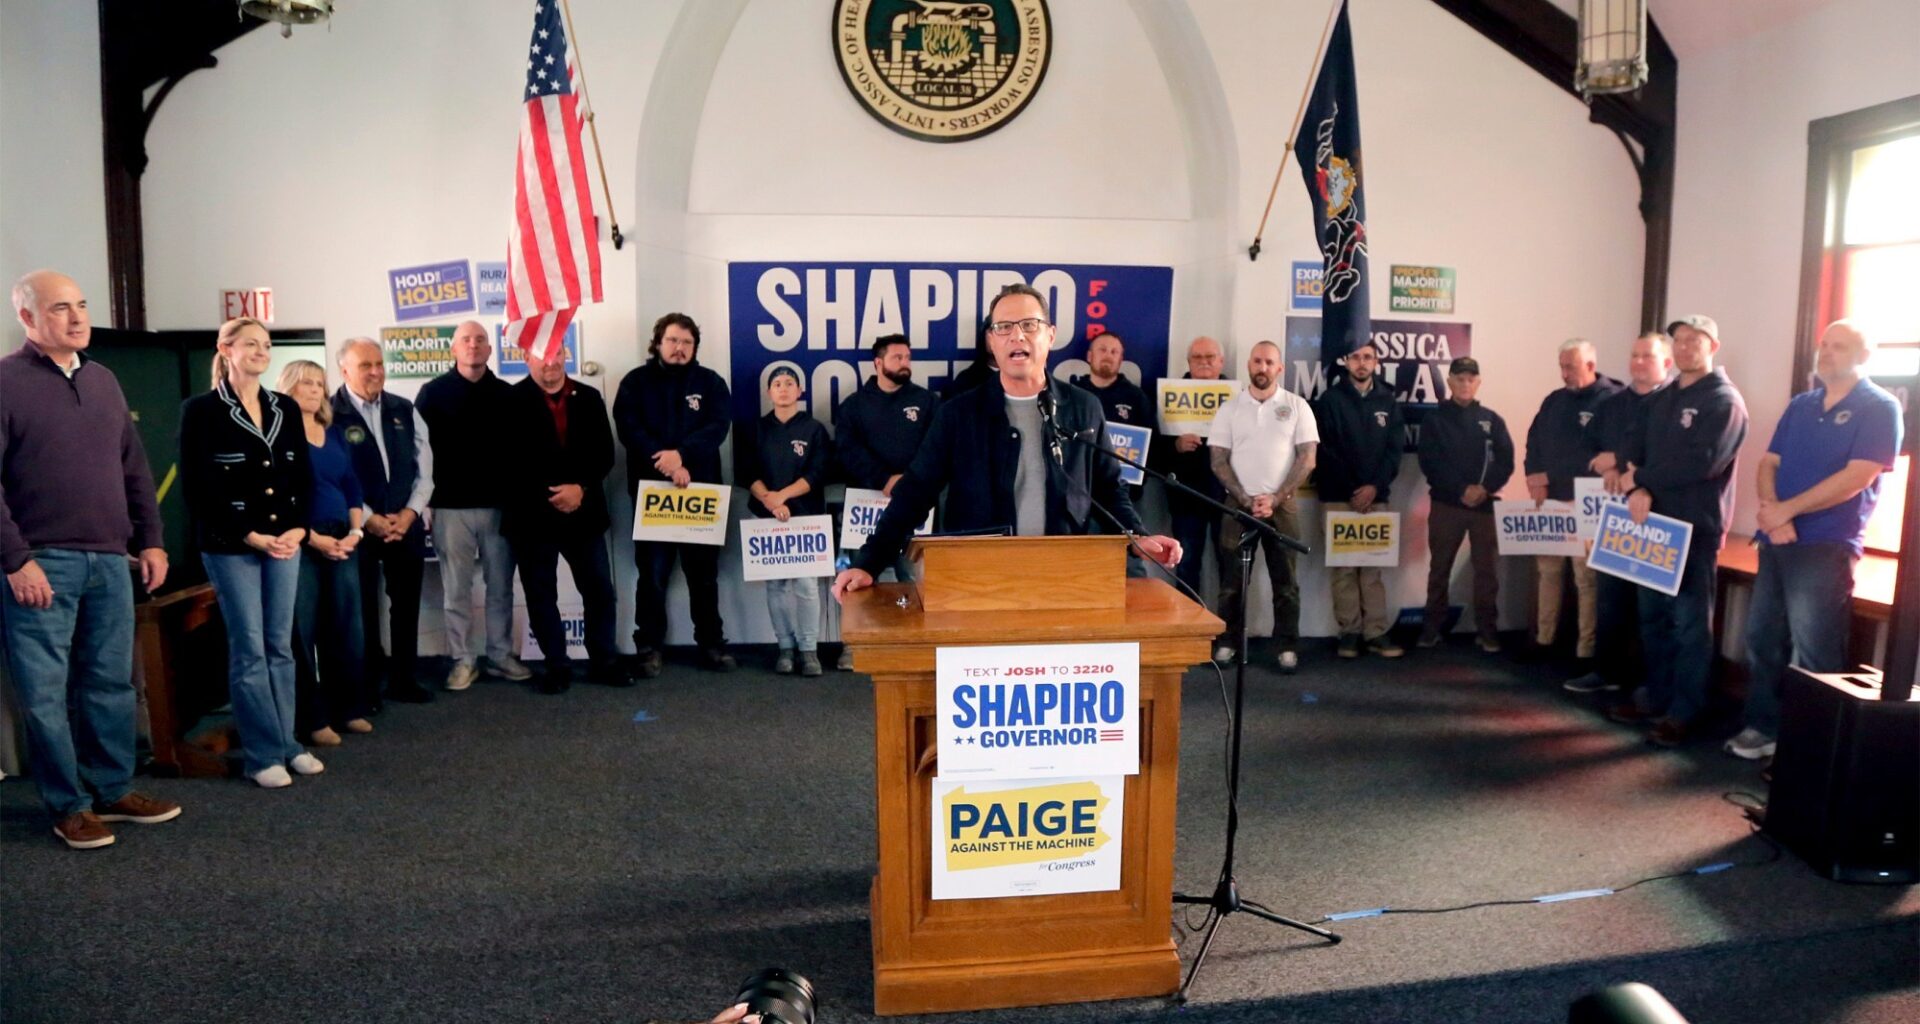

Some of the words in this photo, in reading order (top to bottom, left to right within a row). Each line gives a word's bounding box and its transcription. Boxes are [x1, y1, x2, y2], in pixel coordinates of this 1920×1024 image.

[845, 33, 858, 54] OF
[1020, 6, 1041, 87] ASBESTOS
[852, 57, 891, 106] ASSOC.
[916, 83, 958, 93] LOCAL
[892, 103, 934, 130] INT'L
[950, 89, 1021, 130] WORKERS
[395, 271, 435, 289] HOLD
[1296, 268, 1324, 280] EXPA
[1393, 275, 1452, 288] MAJORITY
[396, 280, 469, 306] HOUSE
[224, 291, 271, 320] EXIT
[1086, 280, 1107, 340] FOR
[385, 337, 454, 351] MAJORITY
[1369, 331, 1452, 361] SSICA
[418, 351, 453, 361] RURA
[645, 494, 717, 516] PAIGE
[1333, 523, 1391, 540] PAIGE
[1503, 515, 1578, 534] SHAPIRO
[1607, 515, 1666, 544] EXPAND
[749, 532, 827, 556] SHAPIRO
[1602, 530, 1679, 571] HOUSE
[762, 555, 816, 566] GOVERNOR
[964, 667, 1000, 677] TEXT
[1004, 666, 1046, 677] JOSH
[1050, 666, 1069, 676] TO
[1072, 664, 1114, 675] 32210
[952, 680, 1125, 729] SHAPIRO
[980, 727, 1097, 748] GOVERNOR
[951, 799, 1098, 840] PAIGE
[950, 841, 1006, 853] AGAINST
[1009, 840, 1033, 851] THE
[1036, 837, 1095, 850] MACHINE
[1048, 858, 1096, 872] Congress
